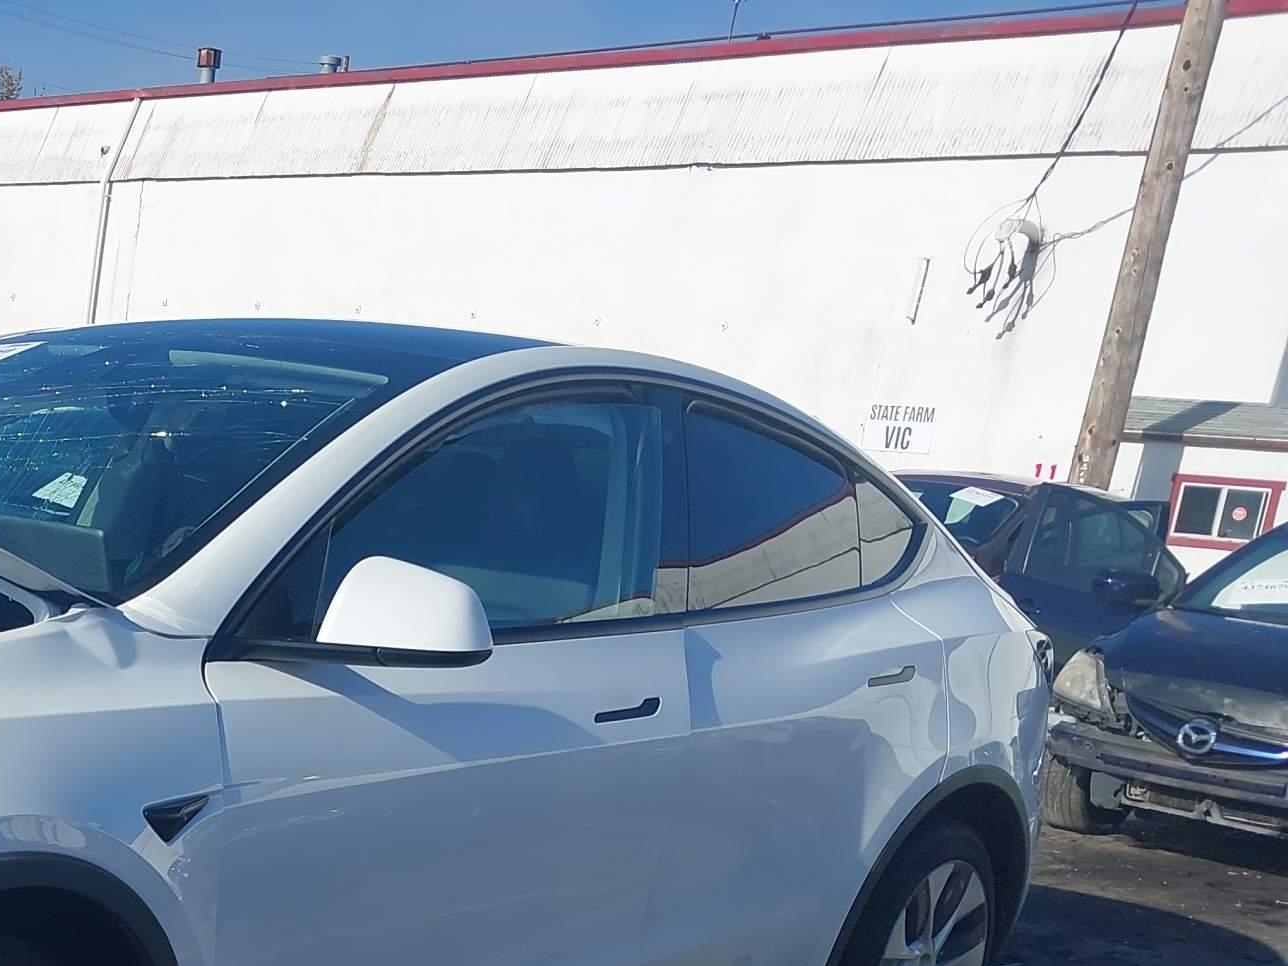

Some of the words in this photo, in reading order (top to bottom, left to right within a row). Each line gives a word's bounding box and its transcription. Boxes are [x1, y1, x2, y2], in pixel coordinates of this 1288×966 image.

[870, 404, 902, 421] STATE
[903, 406, 935, 423] FARM
[884, 425, 912, 449] VIC
